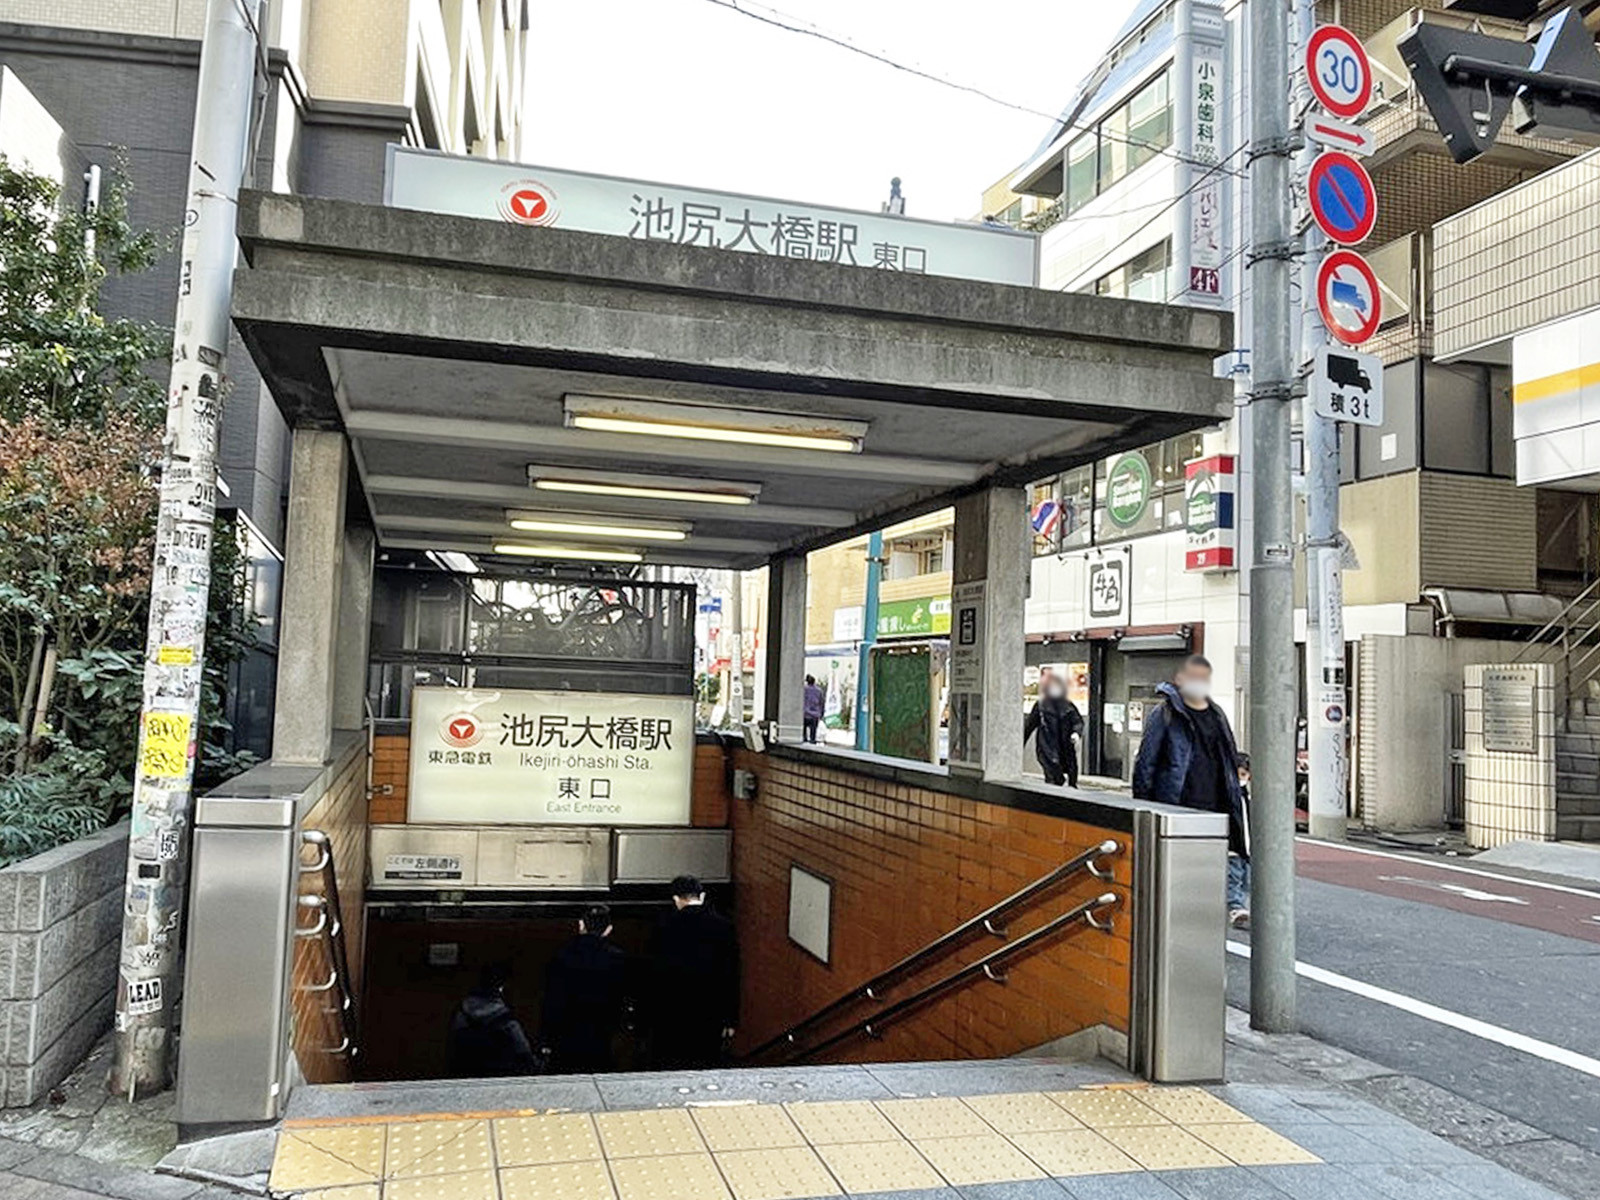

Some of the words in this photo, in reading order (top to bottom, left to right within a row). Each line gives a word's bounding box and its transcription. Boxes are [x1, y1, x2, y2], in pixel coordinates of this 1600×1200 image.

[1322, 49, 1358, 95] 30
[1197, 62, 1215, 144] 小泉歯科
[628, 193, 858, 267] 池尻大橋駅
[872, 241, 927, 274] 東口
[499, 713, 673, 751] 池尻大橋駅
[428, 750, 493, 766] 東急電鉄
[623, 754, 654, 770] Sta.
[558, 777, 611, 799] 東口
[546, 801, 570, 813] East
[573, 802, 622, 813] Entrance
[129, 981, 160, 1003] LEAD
